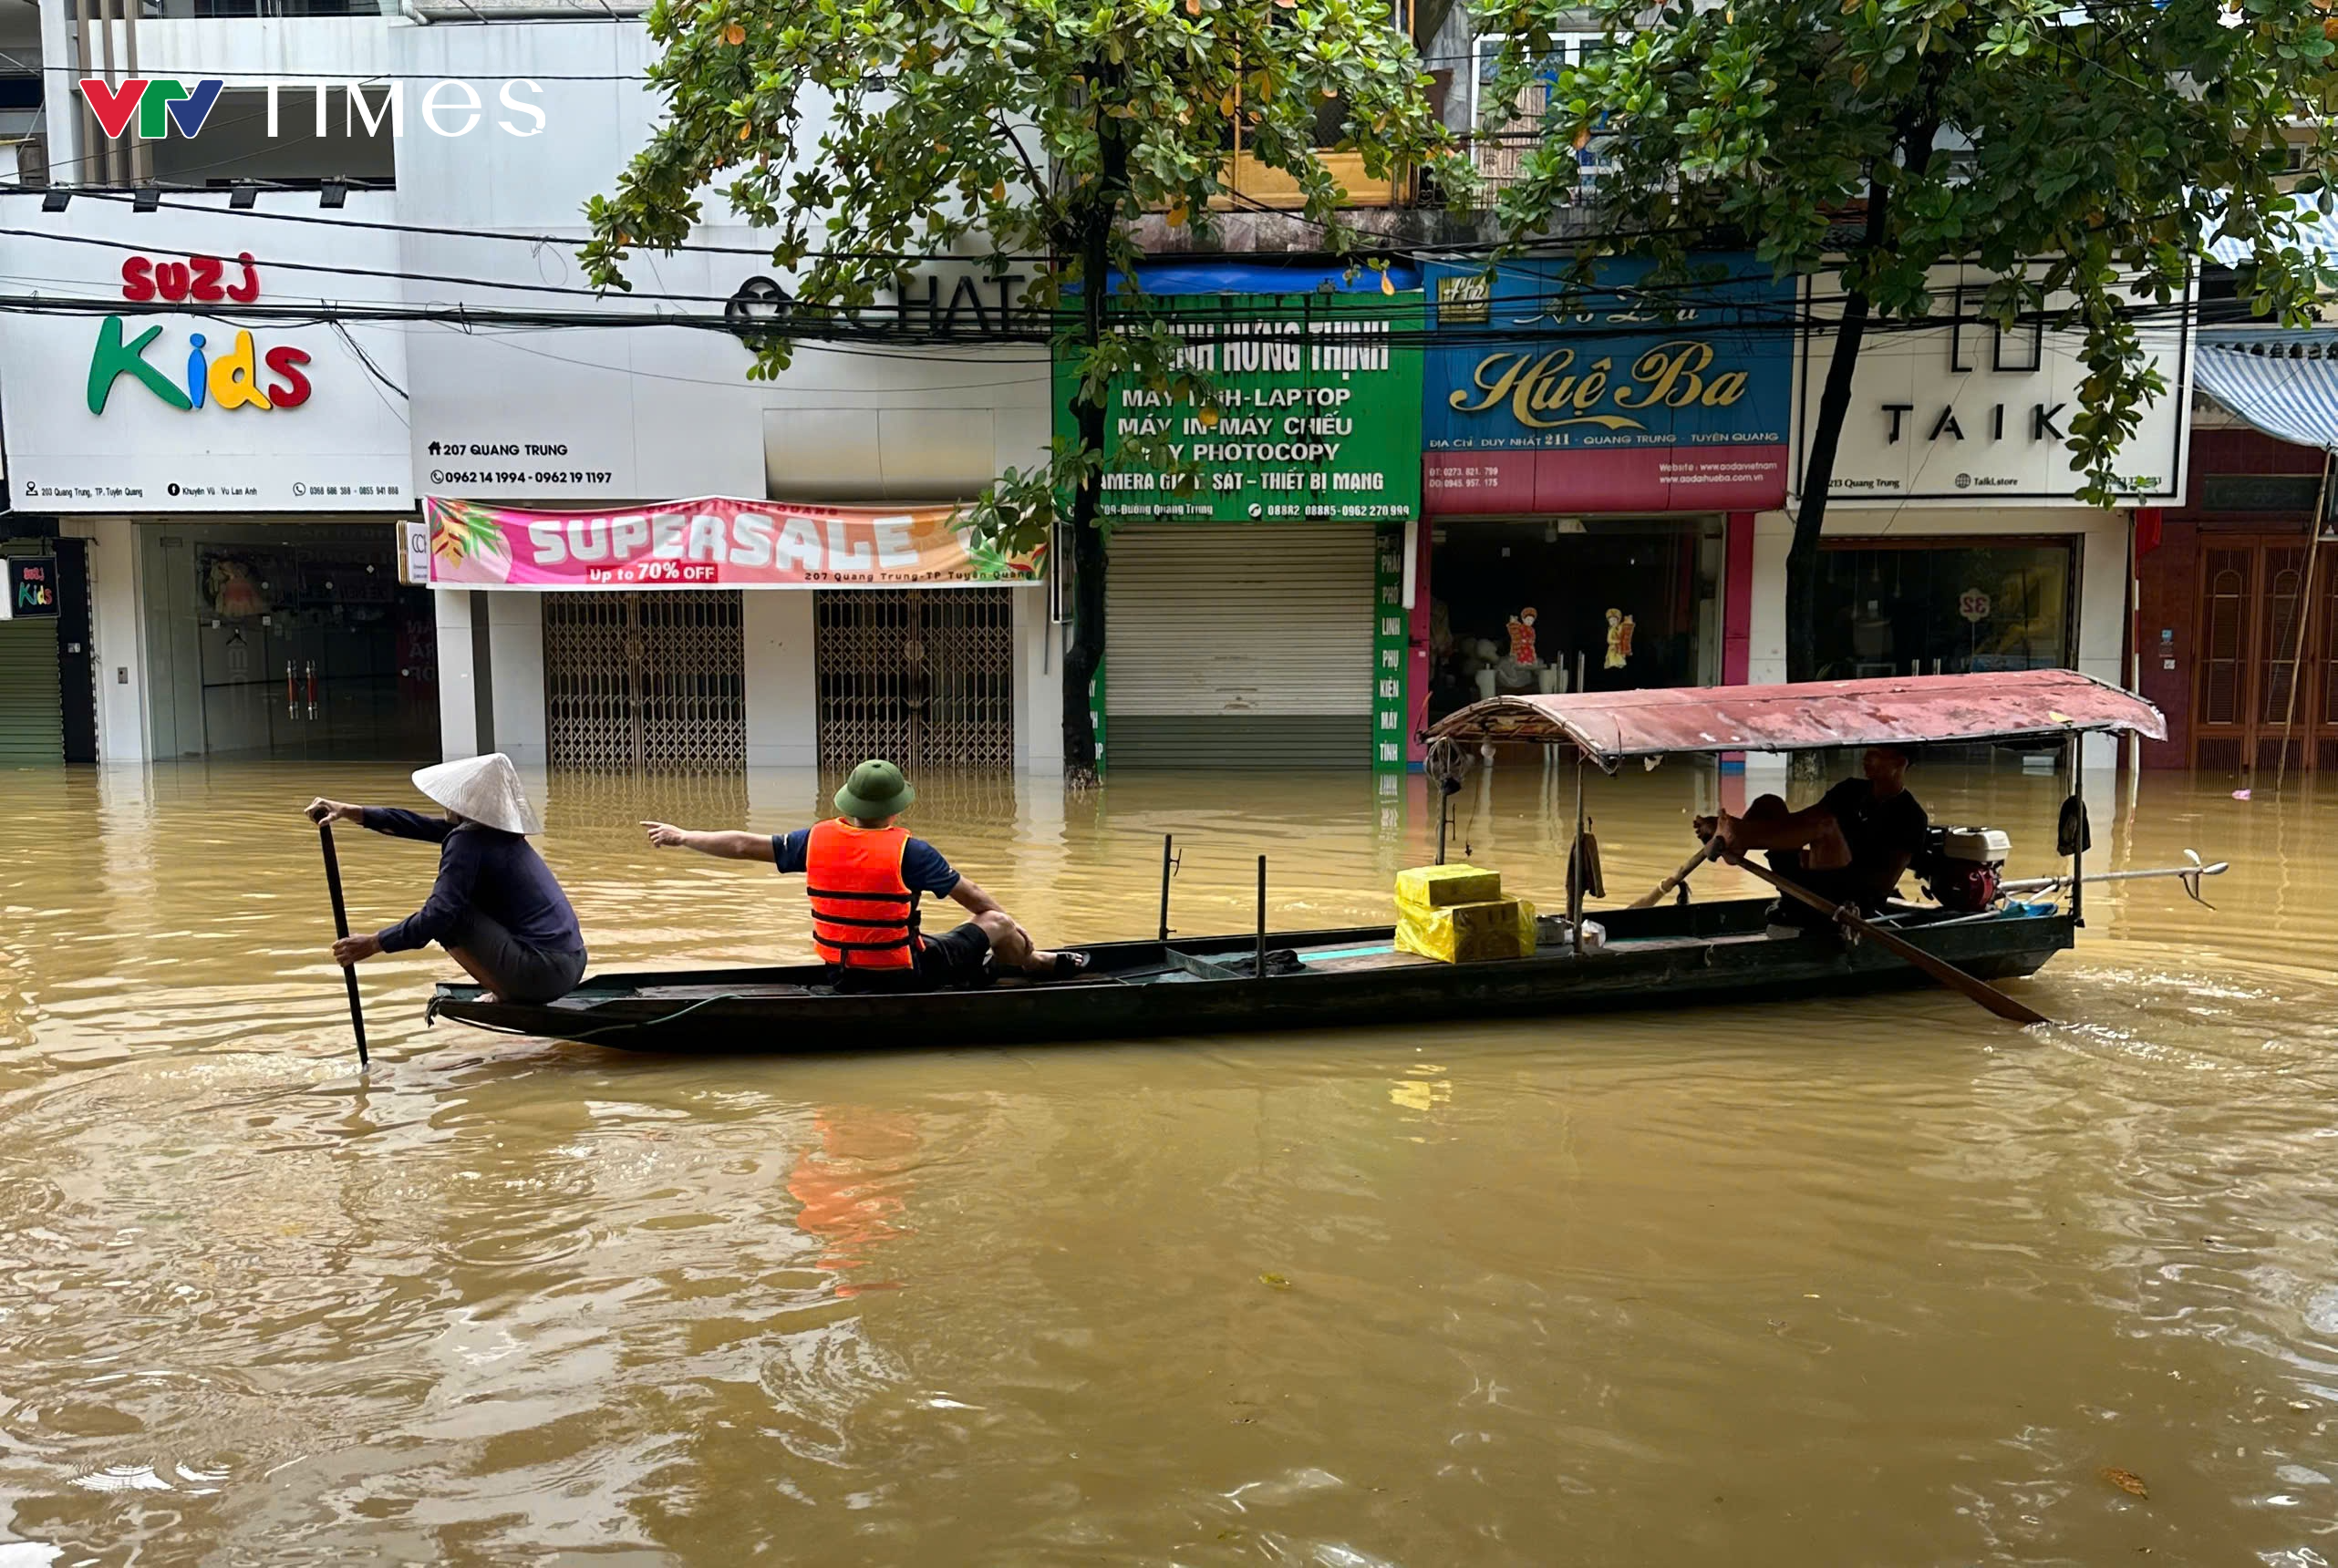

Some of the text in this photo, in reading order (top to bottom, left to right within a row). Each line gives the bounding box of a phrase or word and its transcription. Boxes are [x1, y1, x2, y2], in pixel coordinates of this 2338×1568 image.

[88, 315, 313, 416] Kids
[1614, 341, 1749, 409] Ba
[443, 444, 568, 456] 207 QUANG TRUNG
[1482, 438, 1505, 448] DUY
[1545, 433, 1569, 446] 211
[1583, 435, 1631, 445] QUANG
[1636, 434, 1677, 444] TRUNG
[1732, 432, 1779, 442] QUANG
[1194, 443, 1340, 461] PHOTOCOPY
[445, 471, 612, 483] 0962 14 1994 0962 19 1197
[1101, 472, 1154, 490] AMERA
[1213, 469, 1244, 490] SÁT
[1260, 467, 1305, 490] THIẾT
[1310, 472, 1327, 493] BỊ
[1333, 472, 1383, 493] MẠNG
[1845, 479, 1875, 490] Quang
[1876, 479, 1900, 490] Trung
[1369, 505, 1388, 516] 270
[590, 562, 715, 583] Up to 70% OFF
[804, 573, 828, 581] 207
[834, 573, 874, 583] Quang
[1381, 616, 1401, 635] LINH
[1382, 650, 1400, 672] PHỤ
[1380, 676, 1400, 701] KIỆN
[1381, 708, 1398, 730] MÁY
[1379, 740, 1398, 762] TÍNH
